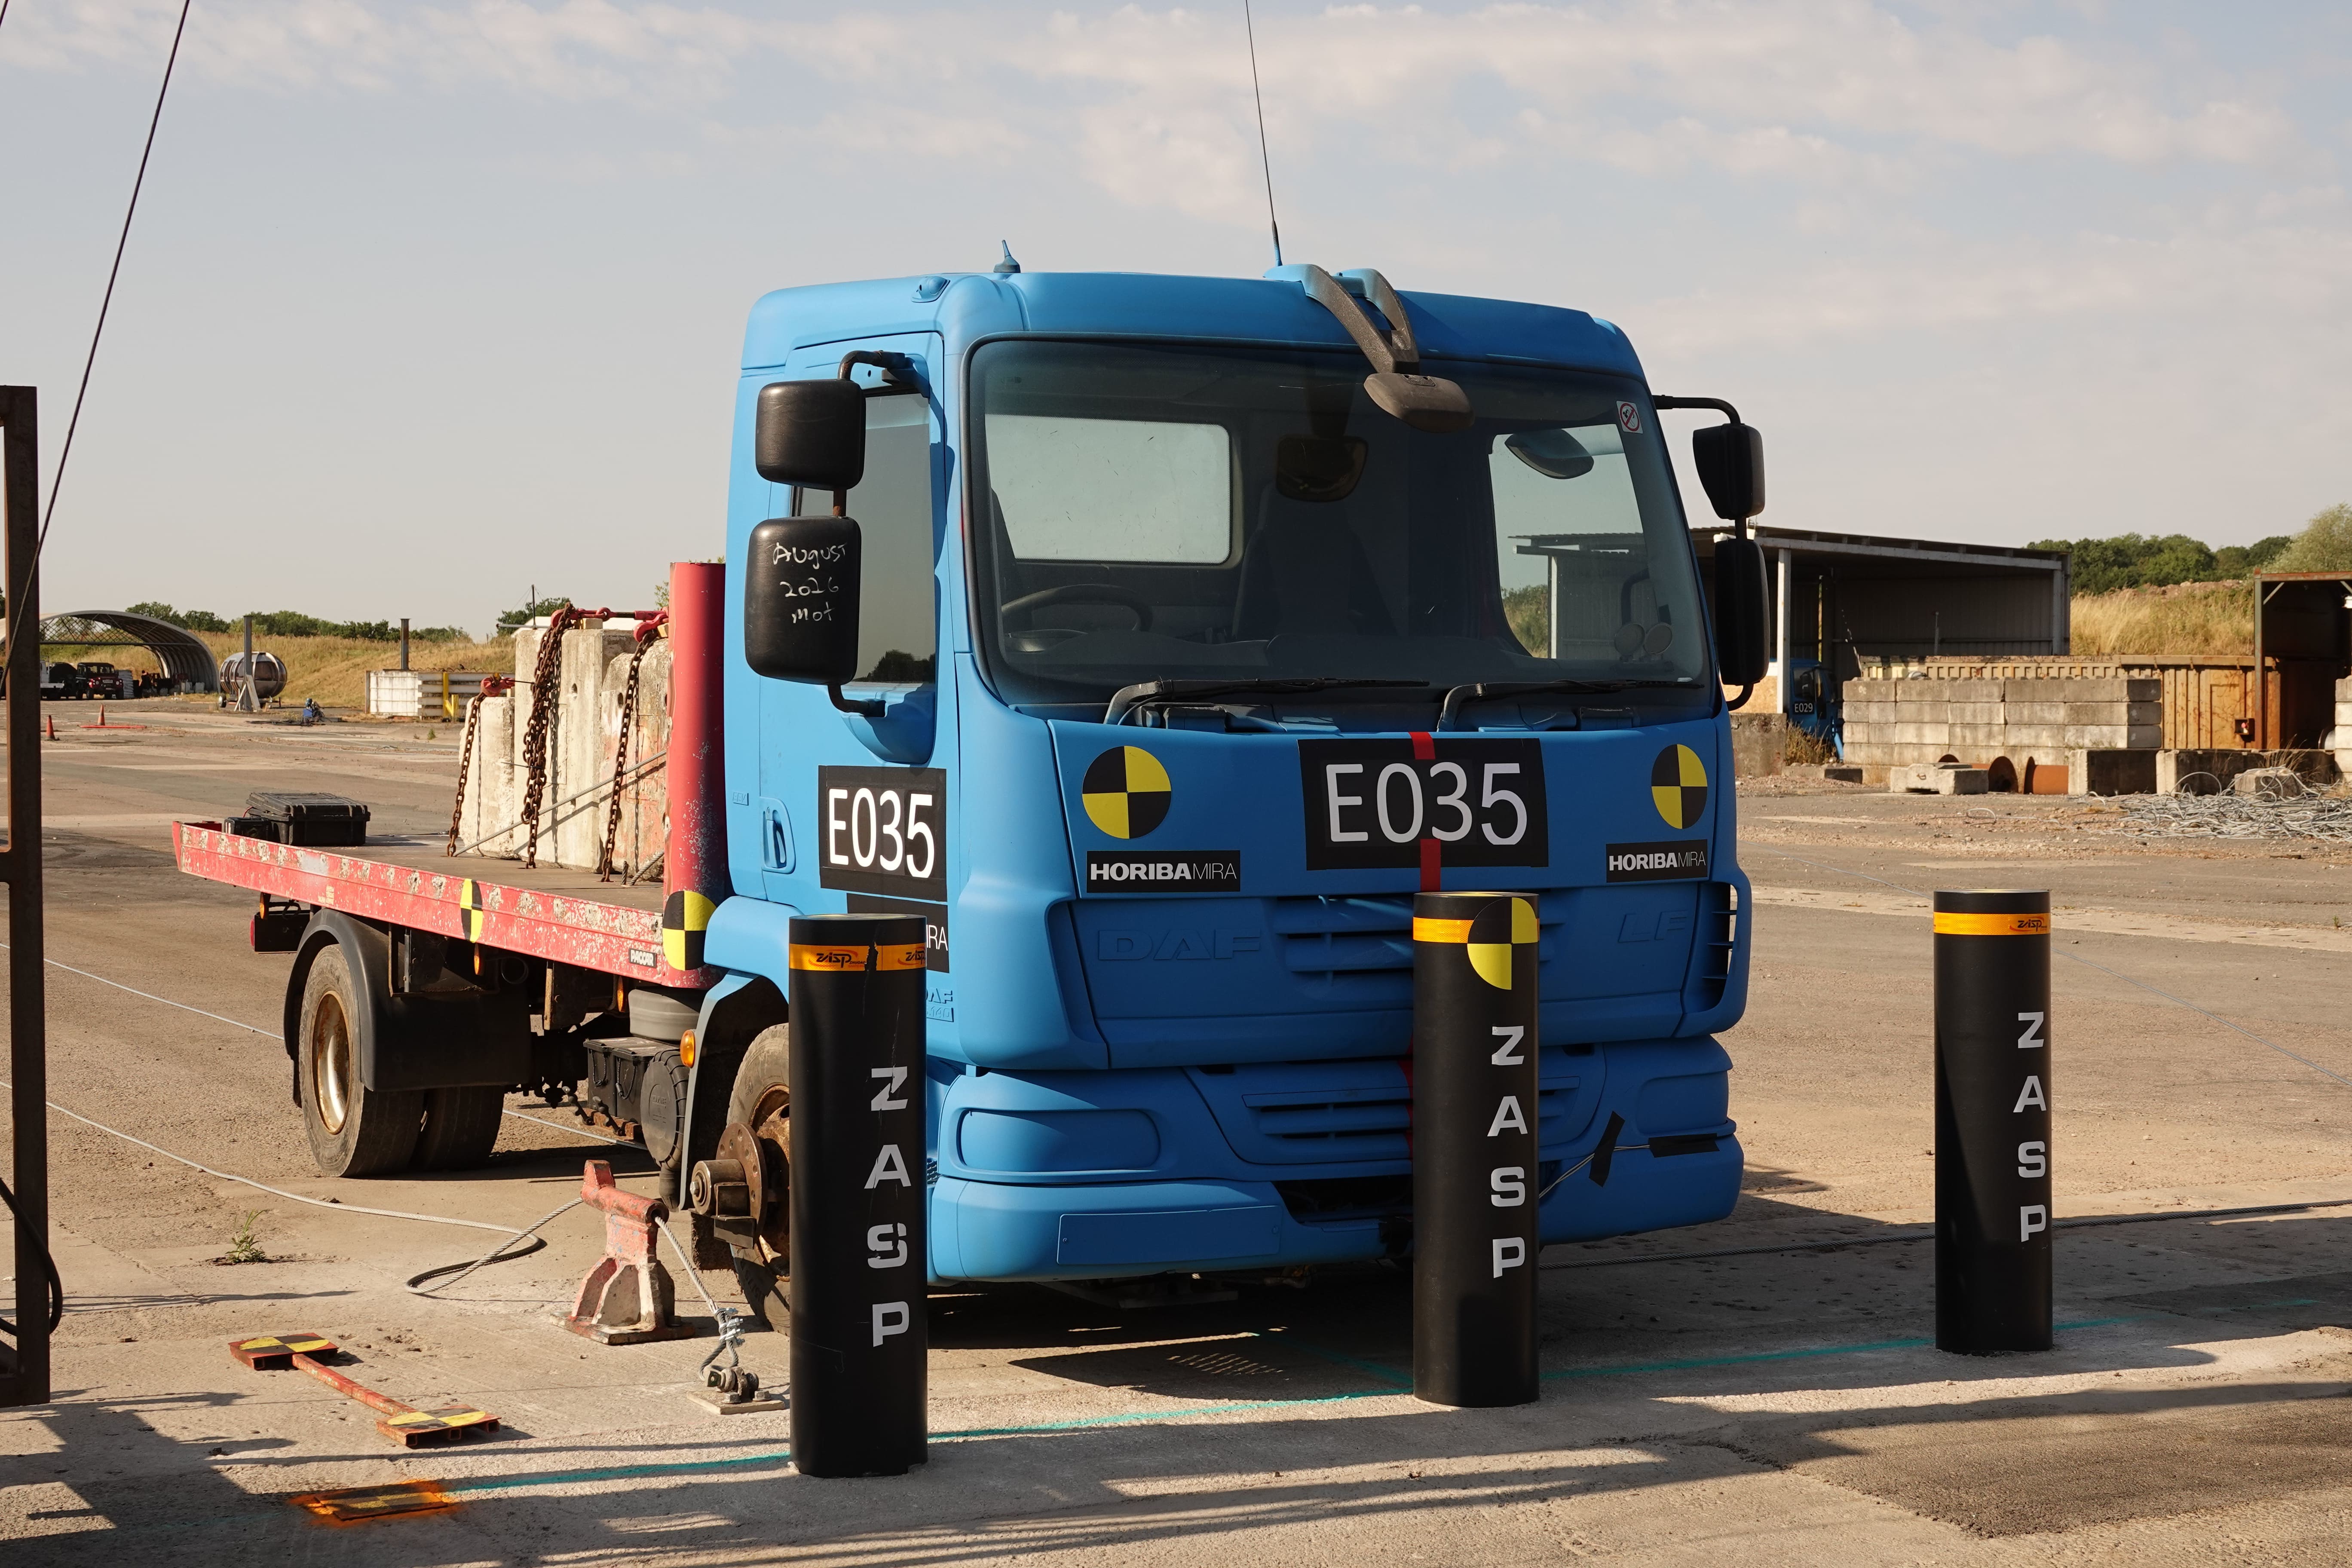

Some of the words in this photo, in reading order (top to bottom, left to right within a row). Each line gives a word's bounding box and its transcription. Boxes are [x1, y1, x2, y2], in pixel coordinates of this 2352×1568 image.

[780, 576, 839, 598] 2026
[1794, 703, 1813, 713] E029
[1326, 762, 1527, 845] E035
[829, 787, 934, 879] E035
[926, 924, 948, 951] IRA
[1618, 910, 1688, 943] LF
[631, 949, 654, 966] PACCAR
[1098, 929, 1261, 961] DAF
